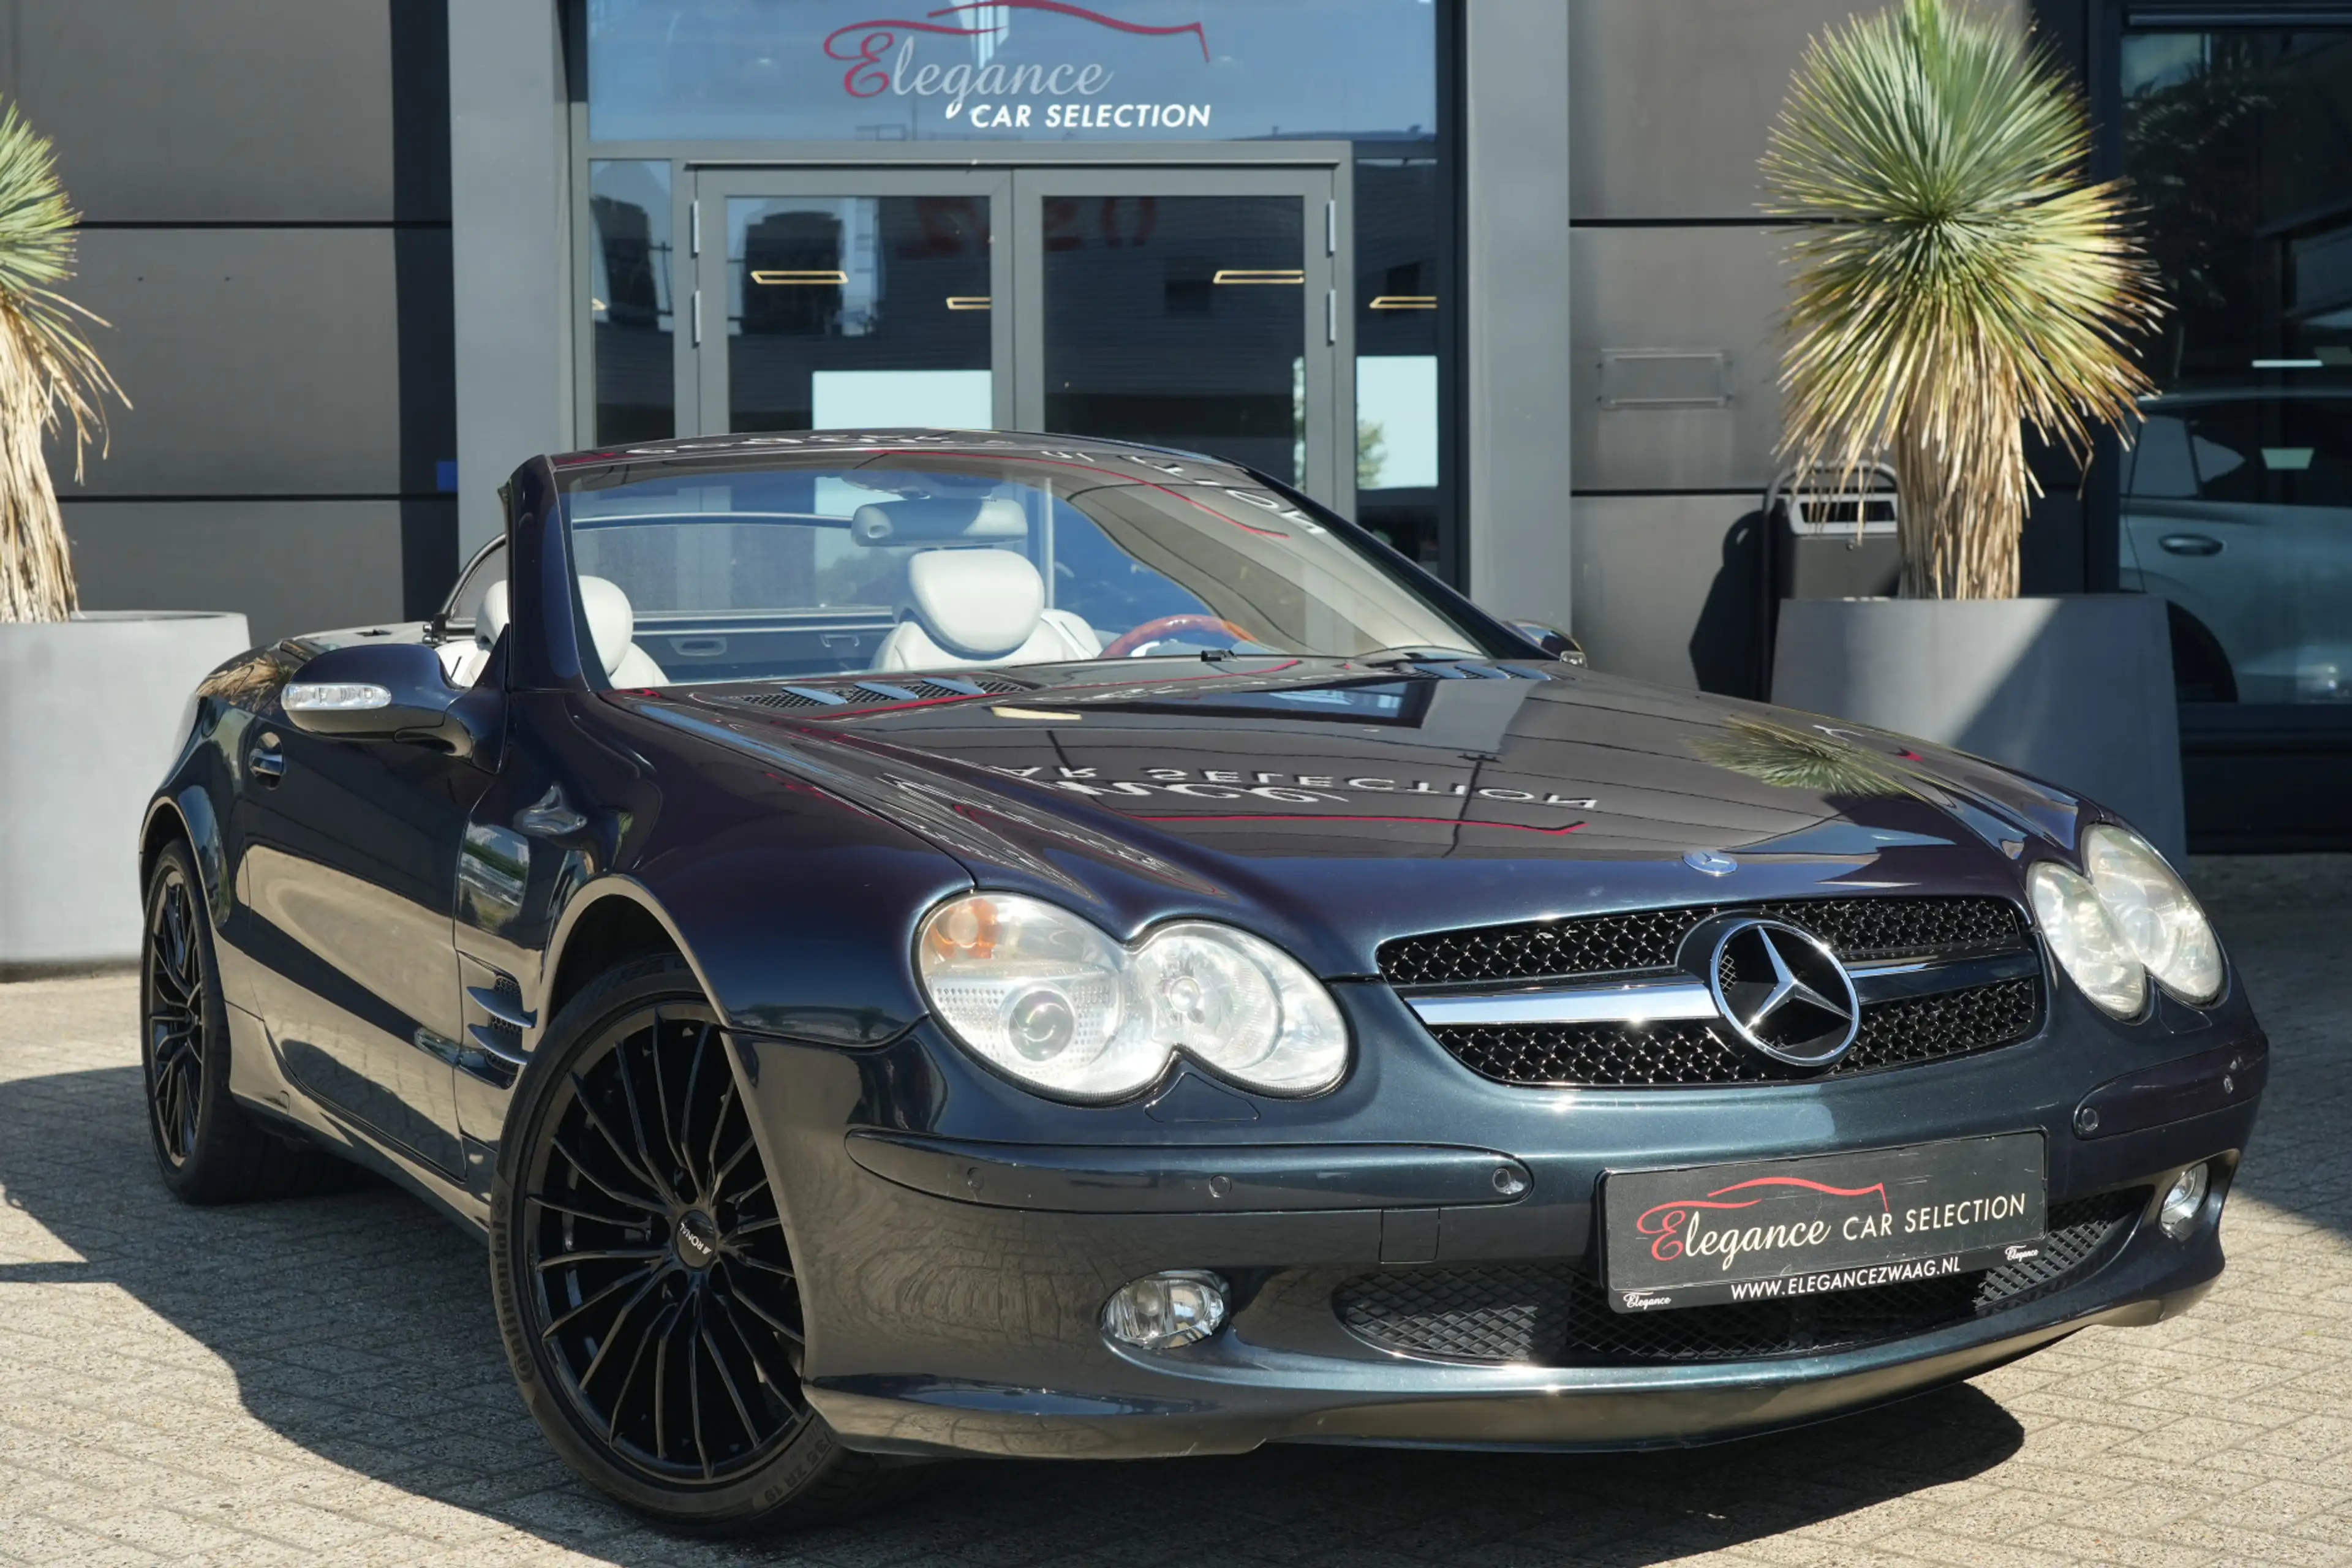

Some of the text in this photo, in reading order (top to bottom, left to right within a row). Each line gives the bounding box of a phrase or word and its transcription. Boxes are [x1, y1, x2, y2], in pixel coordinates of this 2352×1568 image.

[824, 20, 1114, 119] Elegance
[971, 104, 1212, 128] CAR SELECTION
[680, 1223, 704, 1251] RONAL
[1637, 1193, 2026, 1272] Elegance CAR SELECTION
[1730, 1256, 1961, 1300] WWW.ELEGANCEZWAAG.NL
[492, 1221, 535, 1383] Continental
[1623, 1291, 1672, 1310] Elegance
